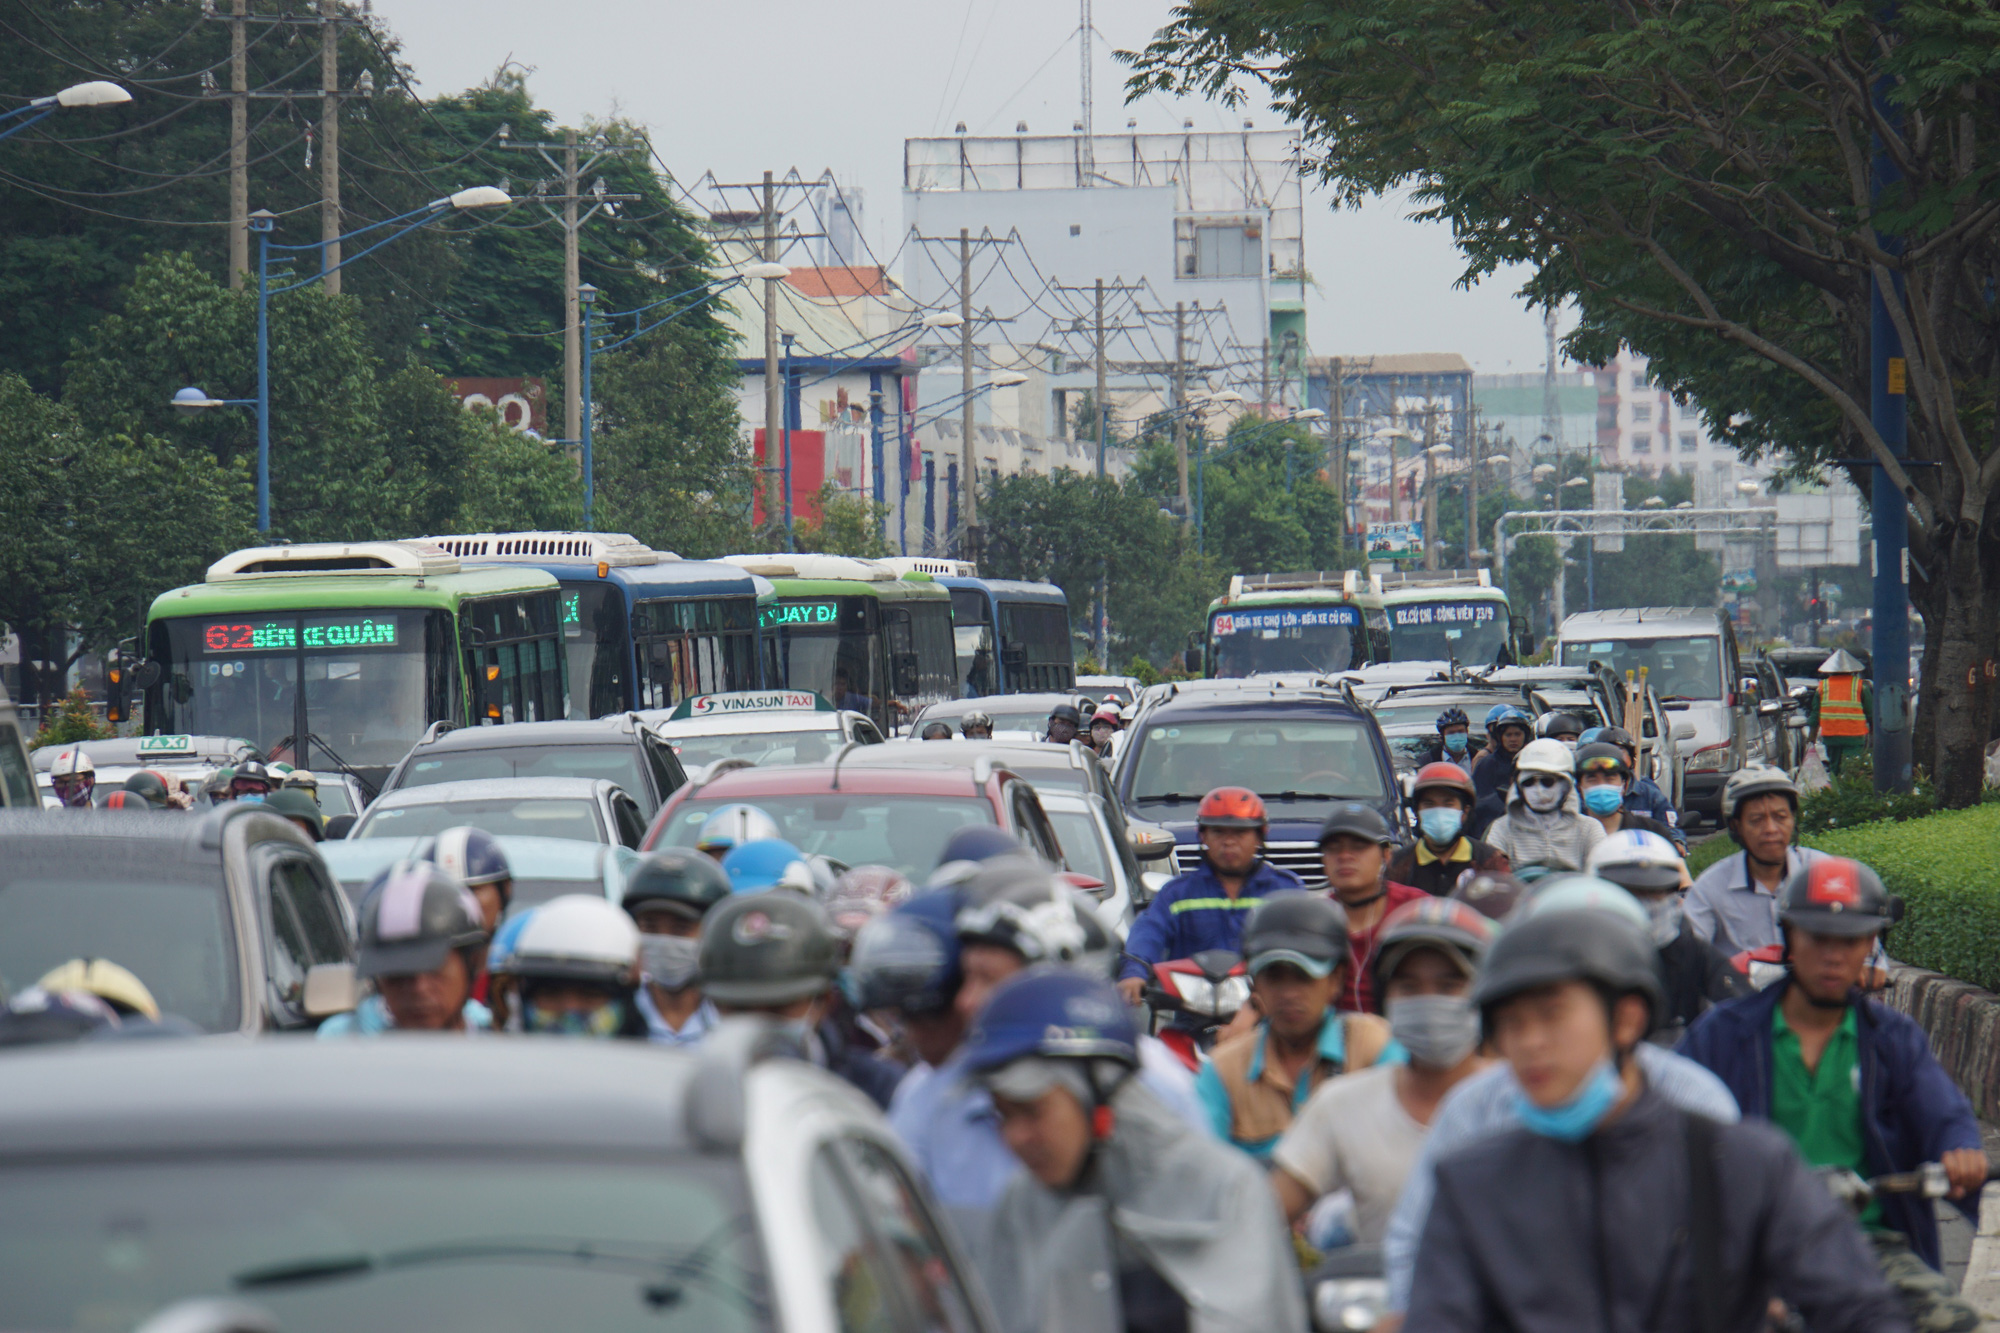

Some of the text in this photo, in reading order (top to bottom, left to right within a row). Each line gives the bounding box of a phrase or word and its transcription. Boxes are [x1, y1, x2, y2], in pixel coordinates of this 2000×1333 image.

[1372, 524, 1411, 535] TIFFY
[1217, 616, 1233, 634] 94
[1252, 616, 1262, 627] XE
[1318, 613, 1328, 624] XE
[1339, 613, 1353, 625] CHI
[206, 625, 254, 649] 62
[722, 694, 813, 710] VINASUN TAXI
